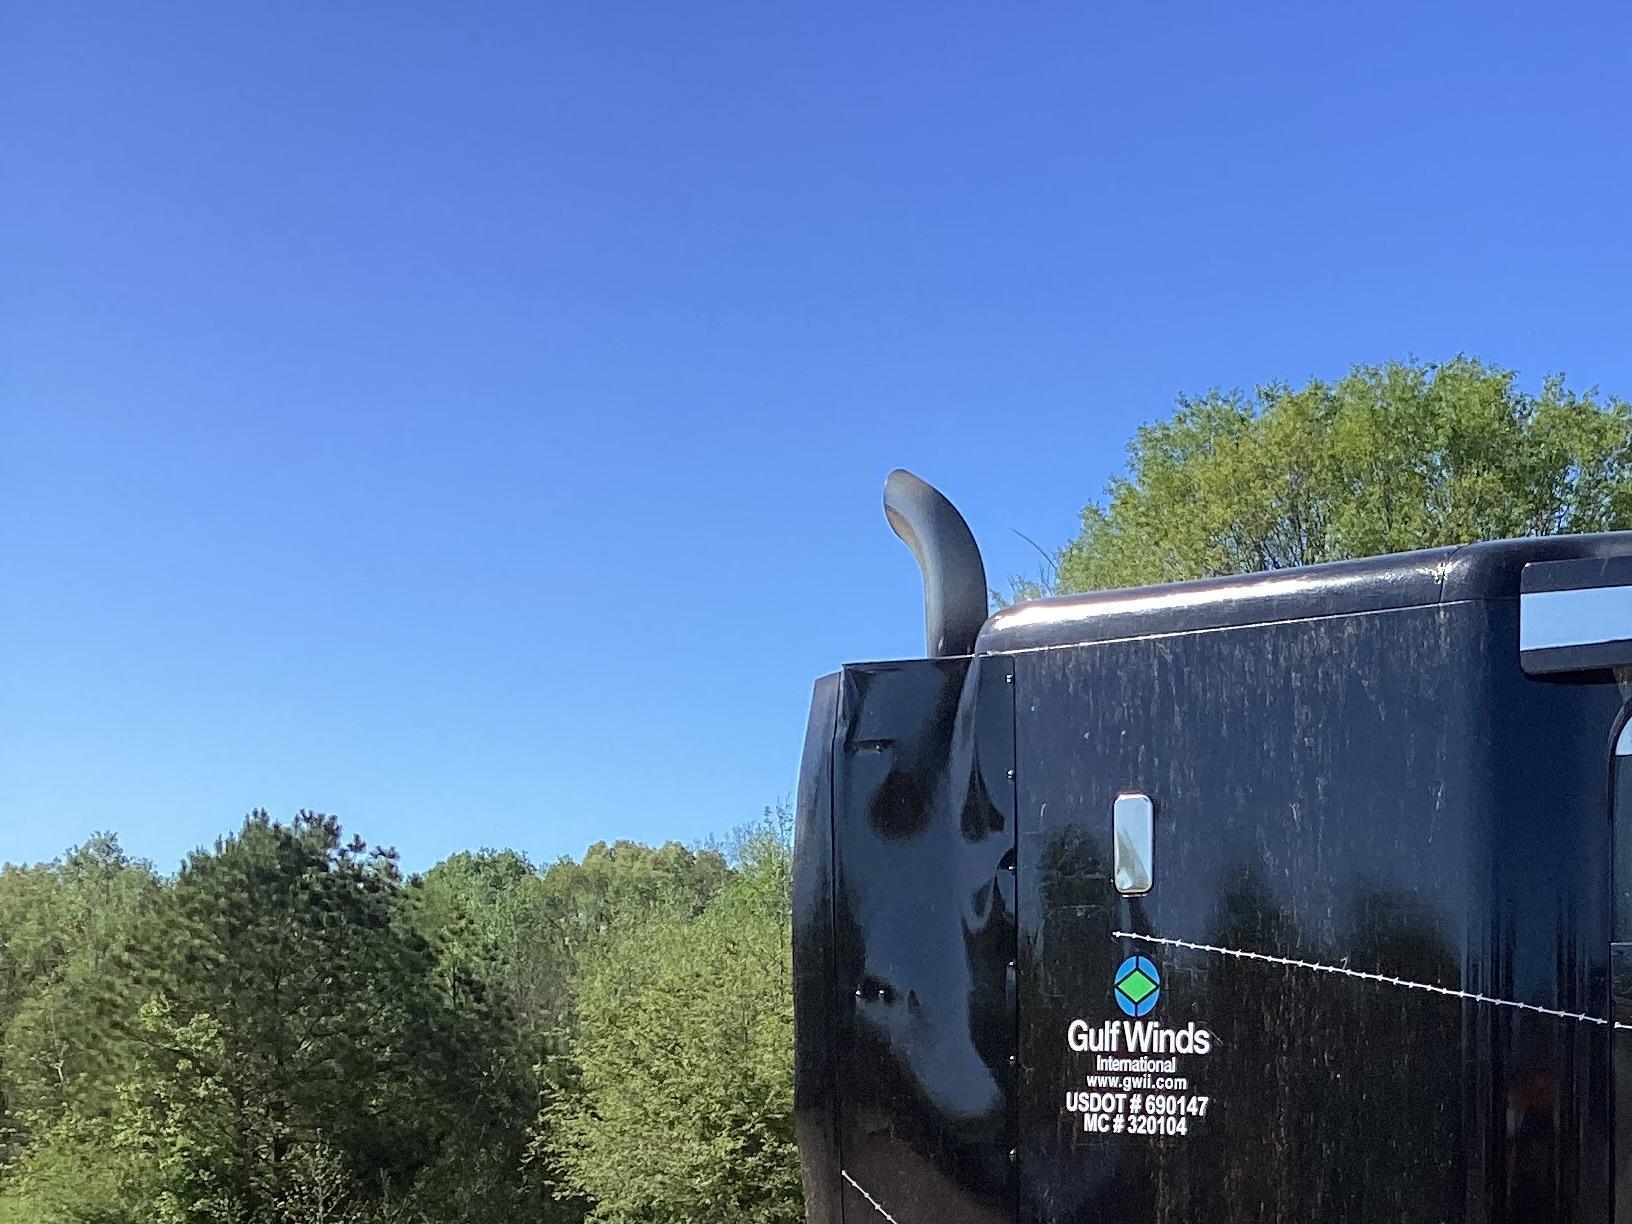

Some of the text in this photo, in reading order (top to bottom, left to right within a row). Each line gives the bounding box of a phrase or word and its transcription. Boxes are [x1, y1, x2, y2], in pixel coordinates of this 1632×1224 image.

[1067, 1019, 1210, 1055] Gulf Winds
[1096, 1055, 1176, 1073] International
[1086, 1075, 1188, 1092] www.gwii.com
[1066, 1091, 1209, 1117] USDOT # 690147
[1083, 1113, 1188, 1135] MC # 320104
